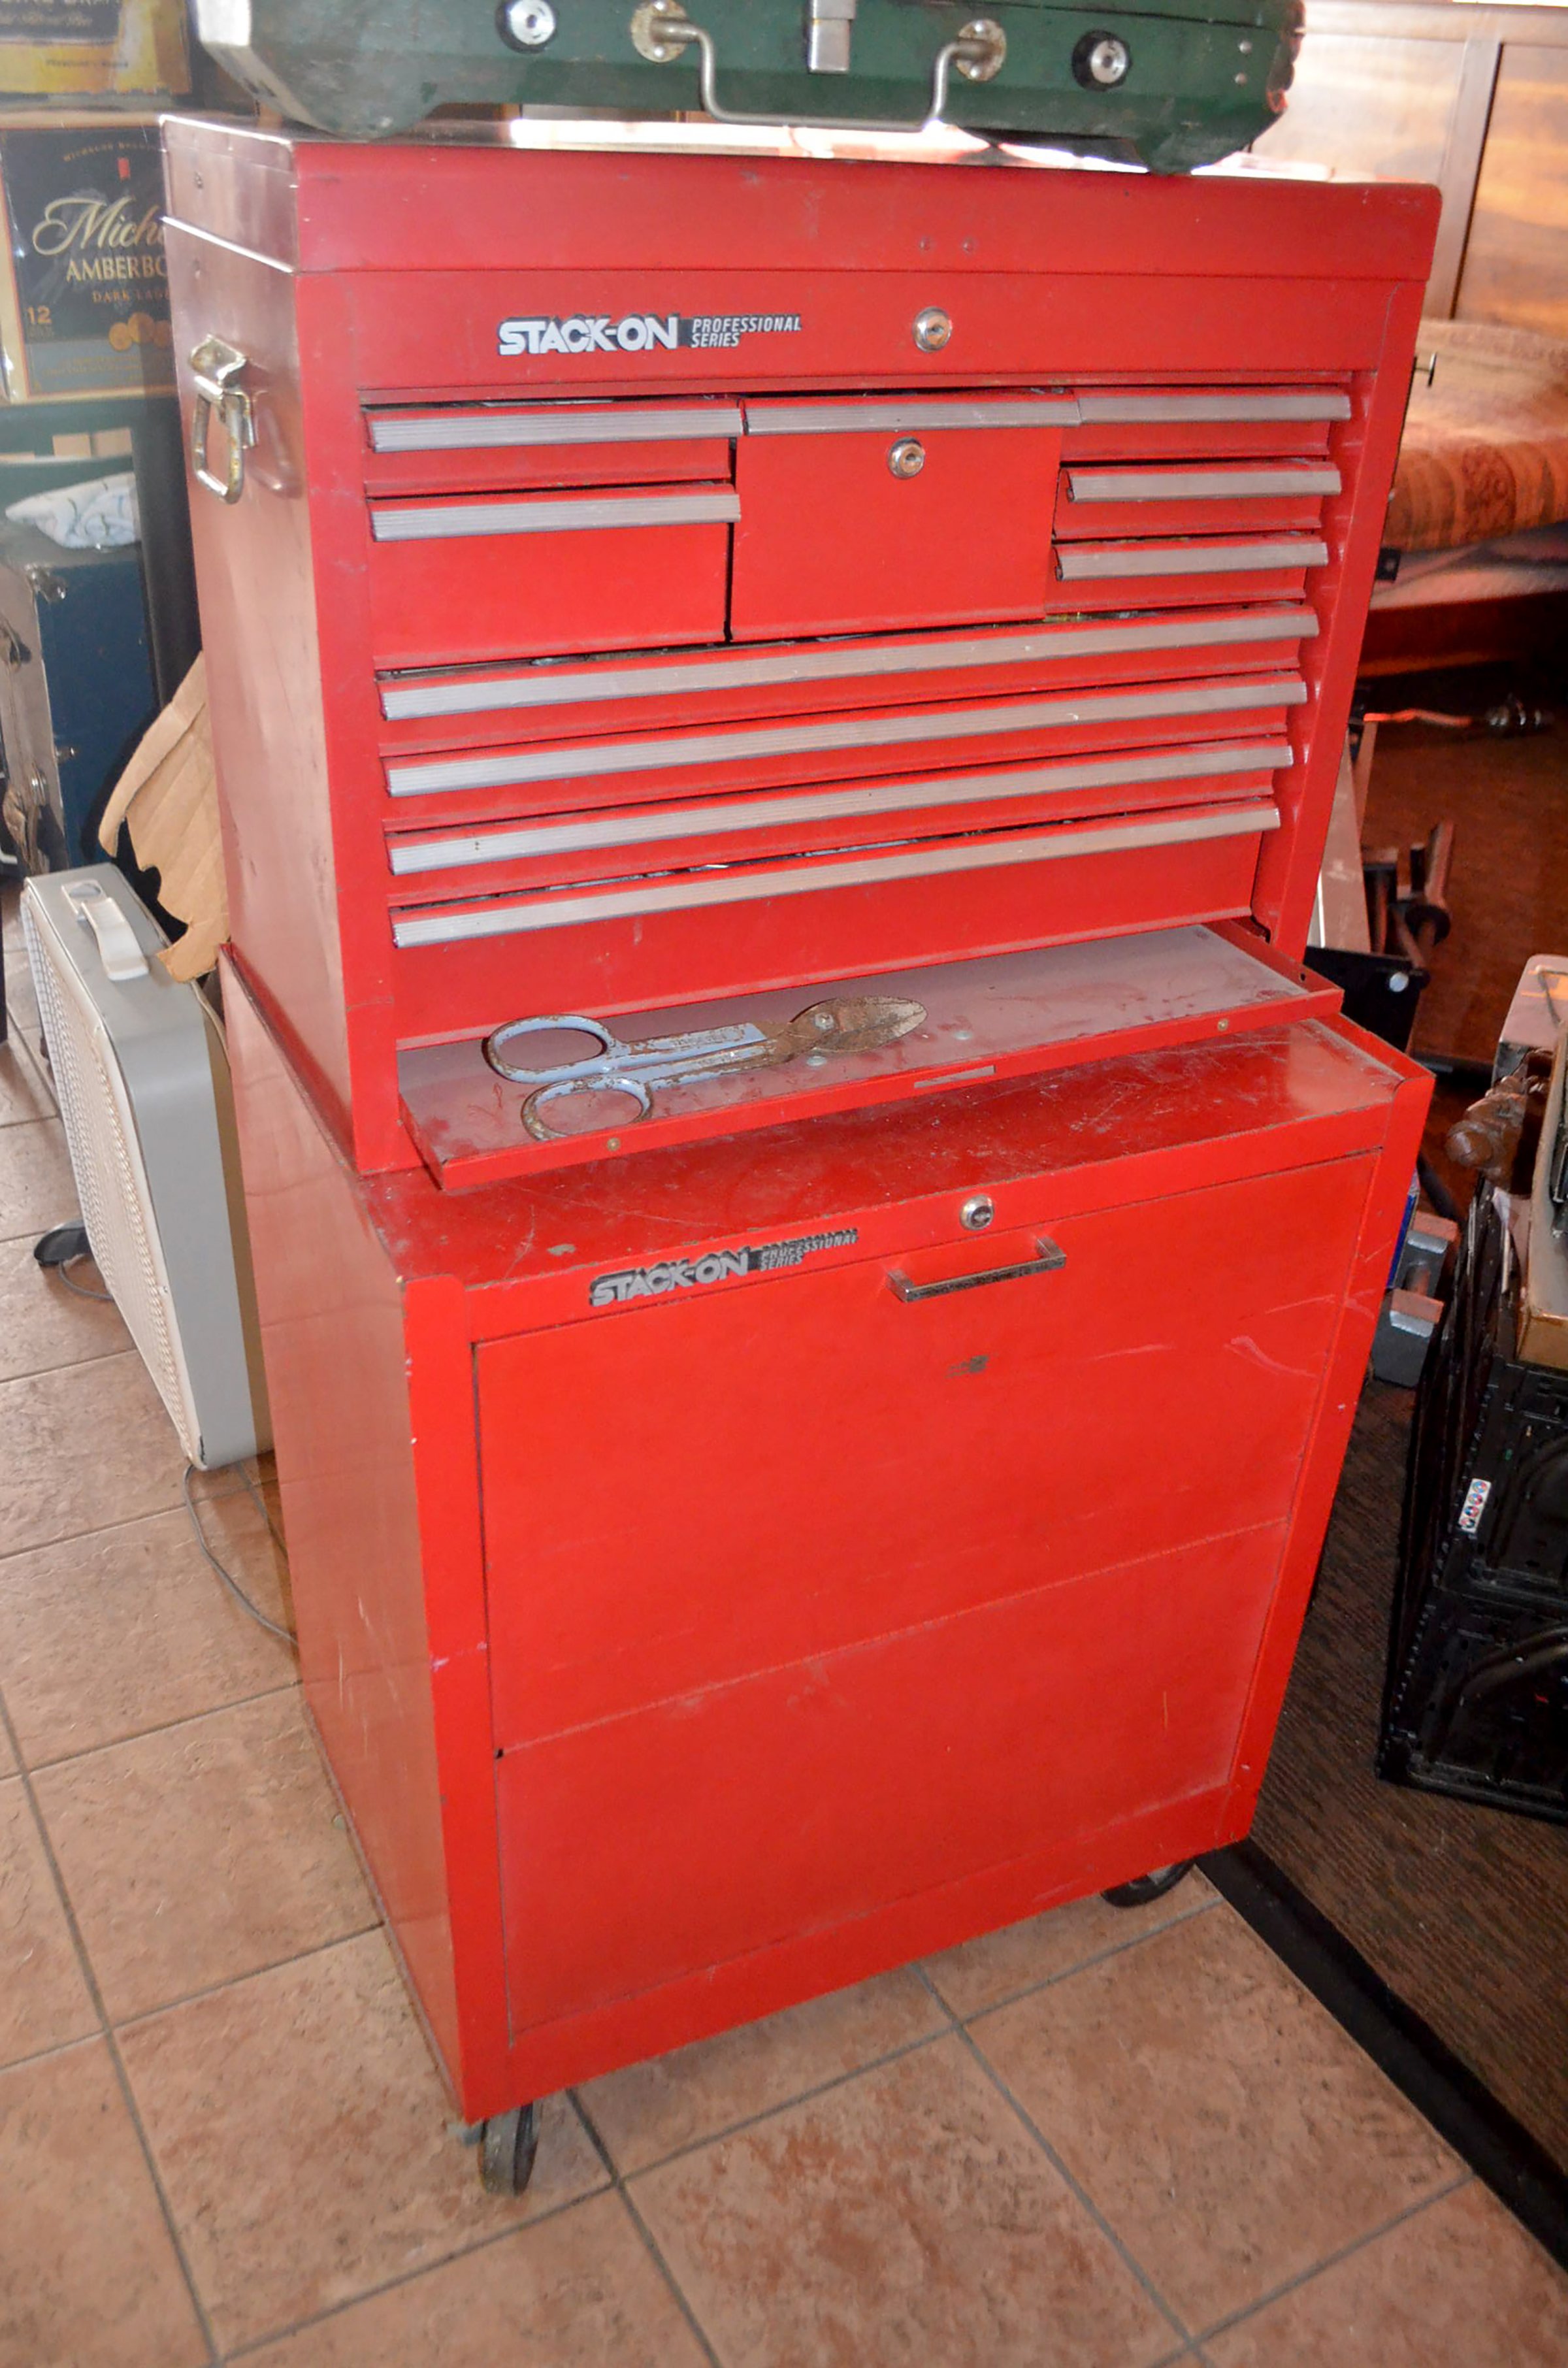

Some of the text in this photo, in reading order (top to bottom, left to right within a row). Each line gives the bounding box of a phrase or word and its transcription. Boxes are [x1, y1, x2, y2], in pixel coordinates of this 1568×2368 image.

[92, 289, 130, 303] DARK
[27, 305, 52, 325] 12
[499, 315, 802, 355] STACK-ON PROFESSIONAL
[690, 331, 741, 348] SERIES
[591, 1230, 859, 1307] STACK-ON PROFESSIONAL
[759, 1253, 806, 1272] SERIES
